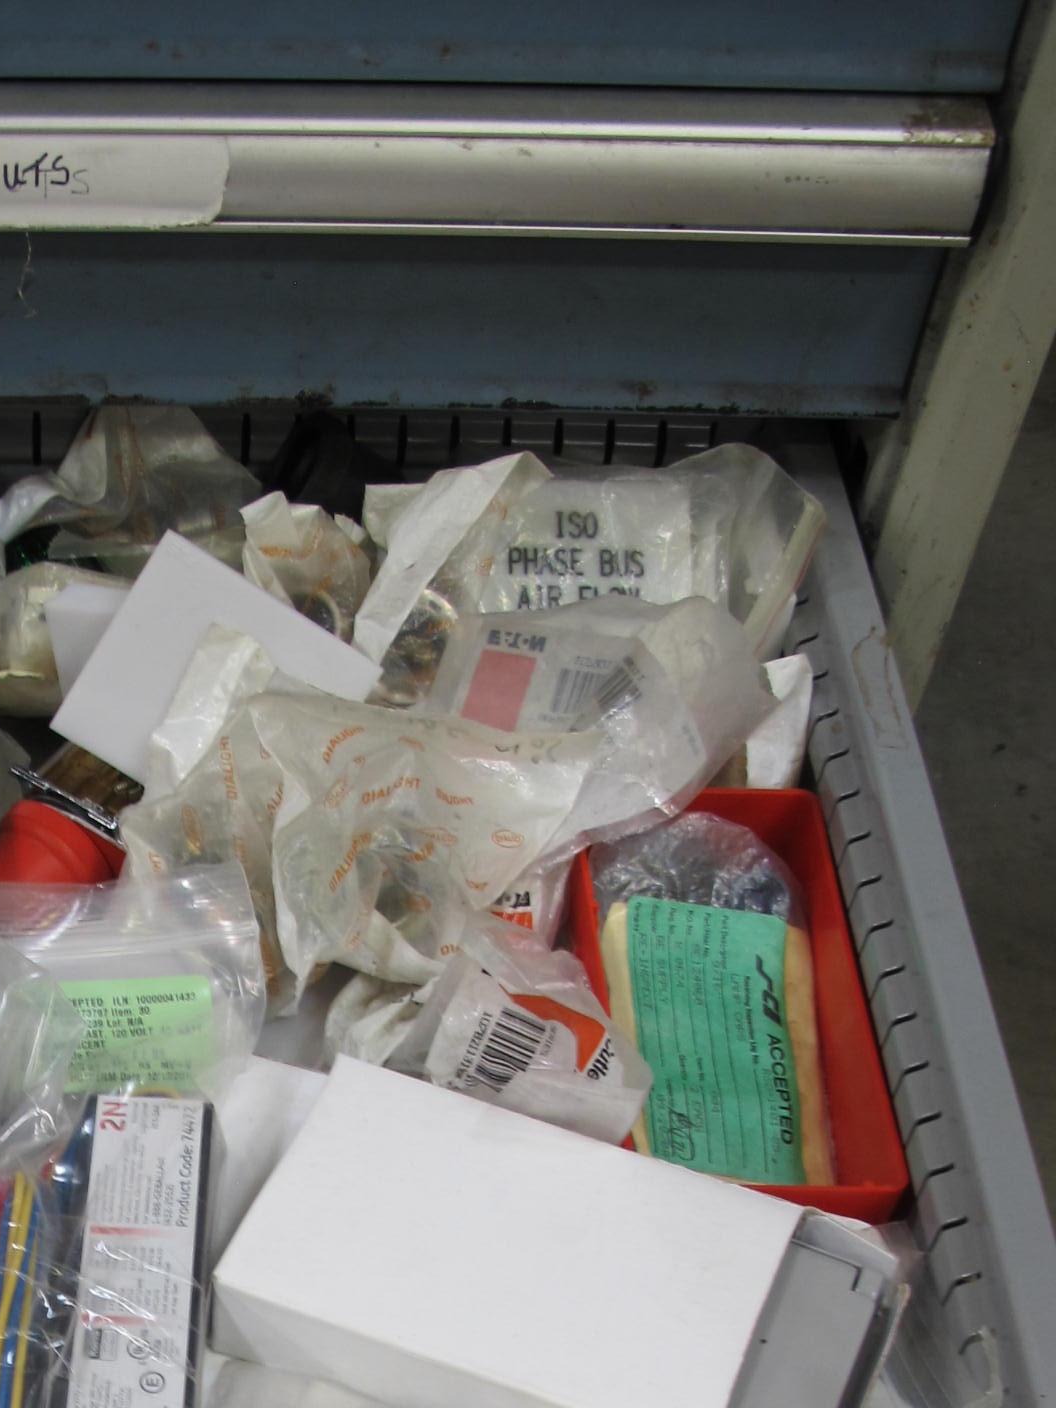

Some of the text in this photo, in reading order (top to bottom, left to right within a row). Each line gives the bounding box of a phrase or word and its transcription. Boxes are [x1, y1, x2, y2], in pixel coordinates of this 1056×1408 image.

[555, 511, 598, 539] ISO
[508, 548, 644, 577] PHASE BUS
[768, 1034, 793, 1146] ACCEPTED
[100, 1101, 127, 1132] 2N
[181, 1143, 196, 1181] Code:
[175, 1182, 191, 1229] Product
